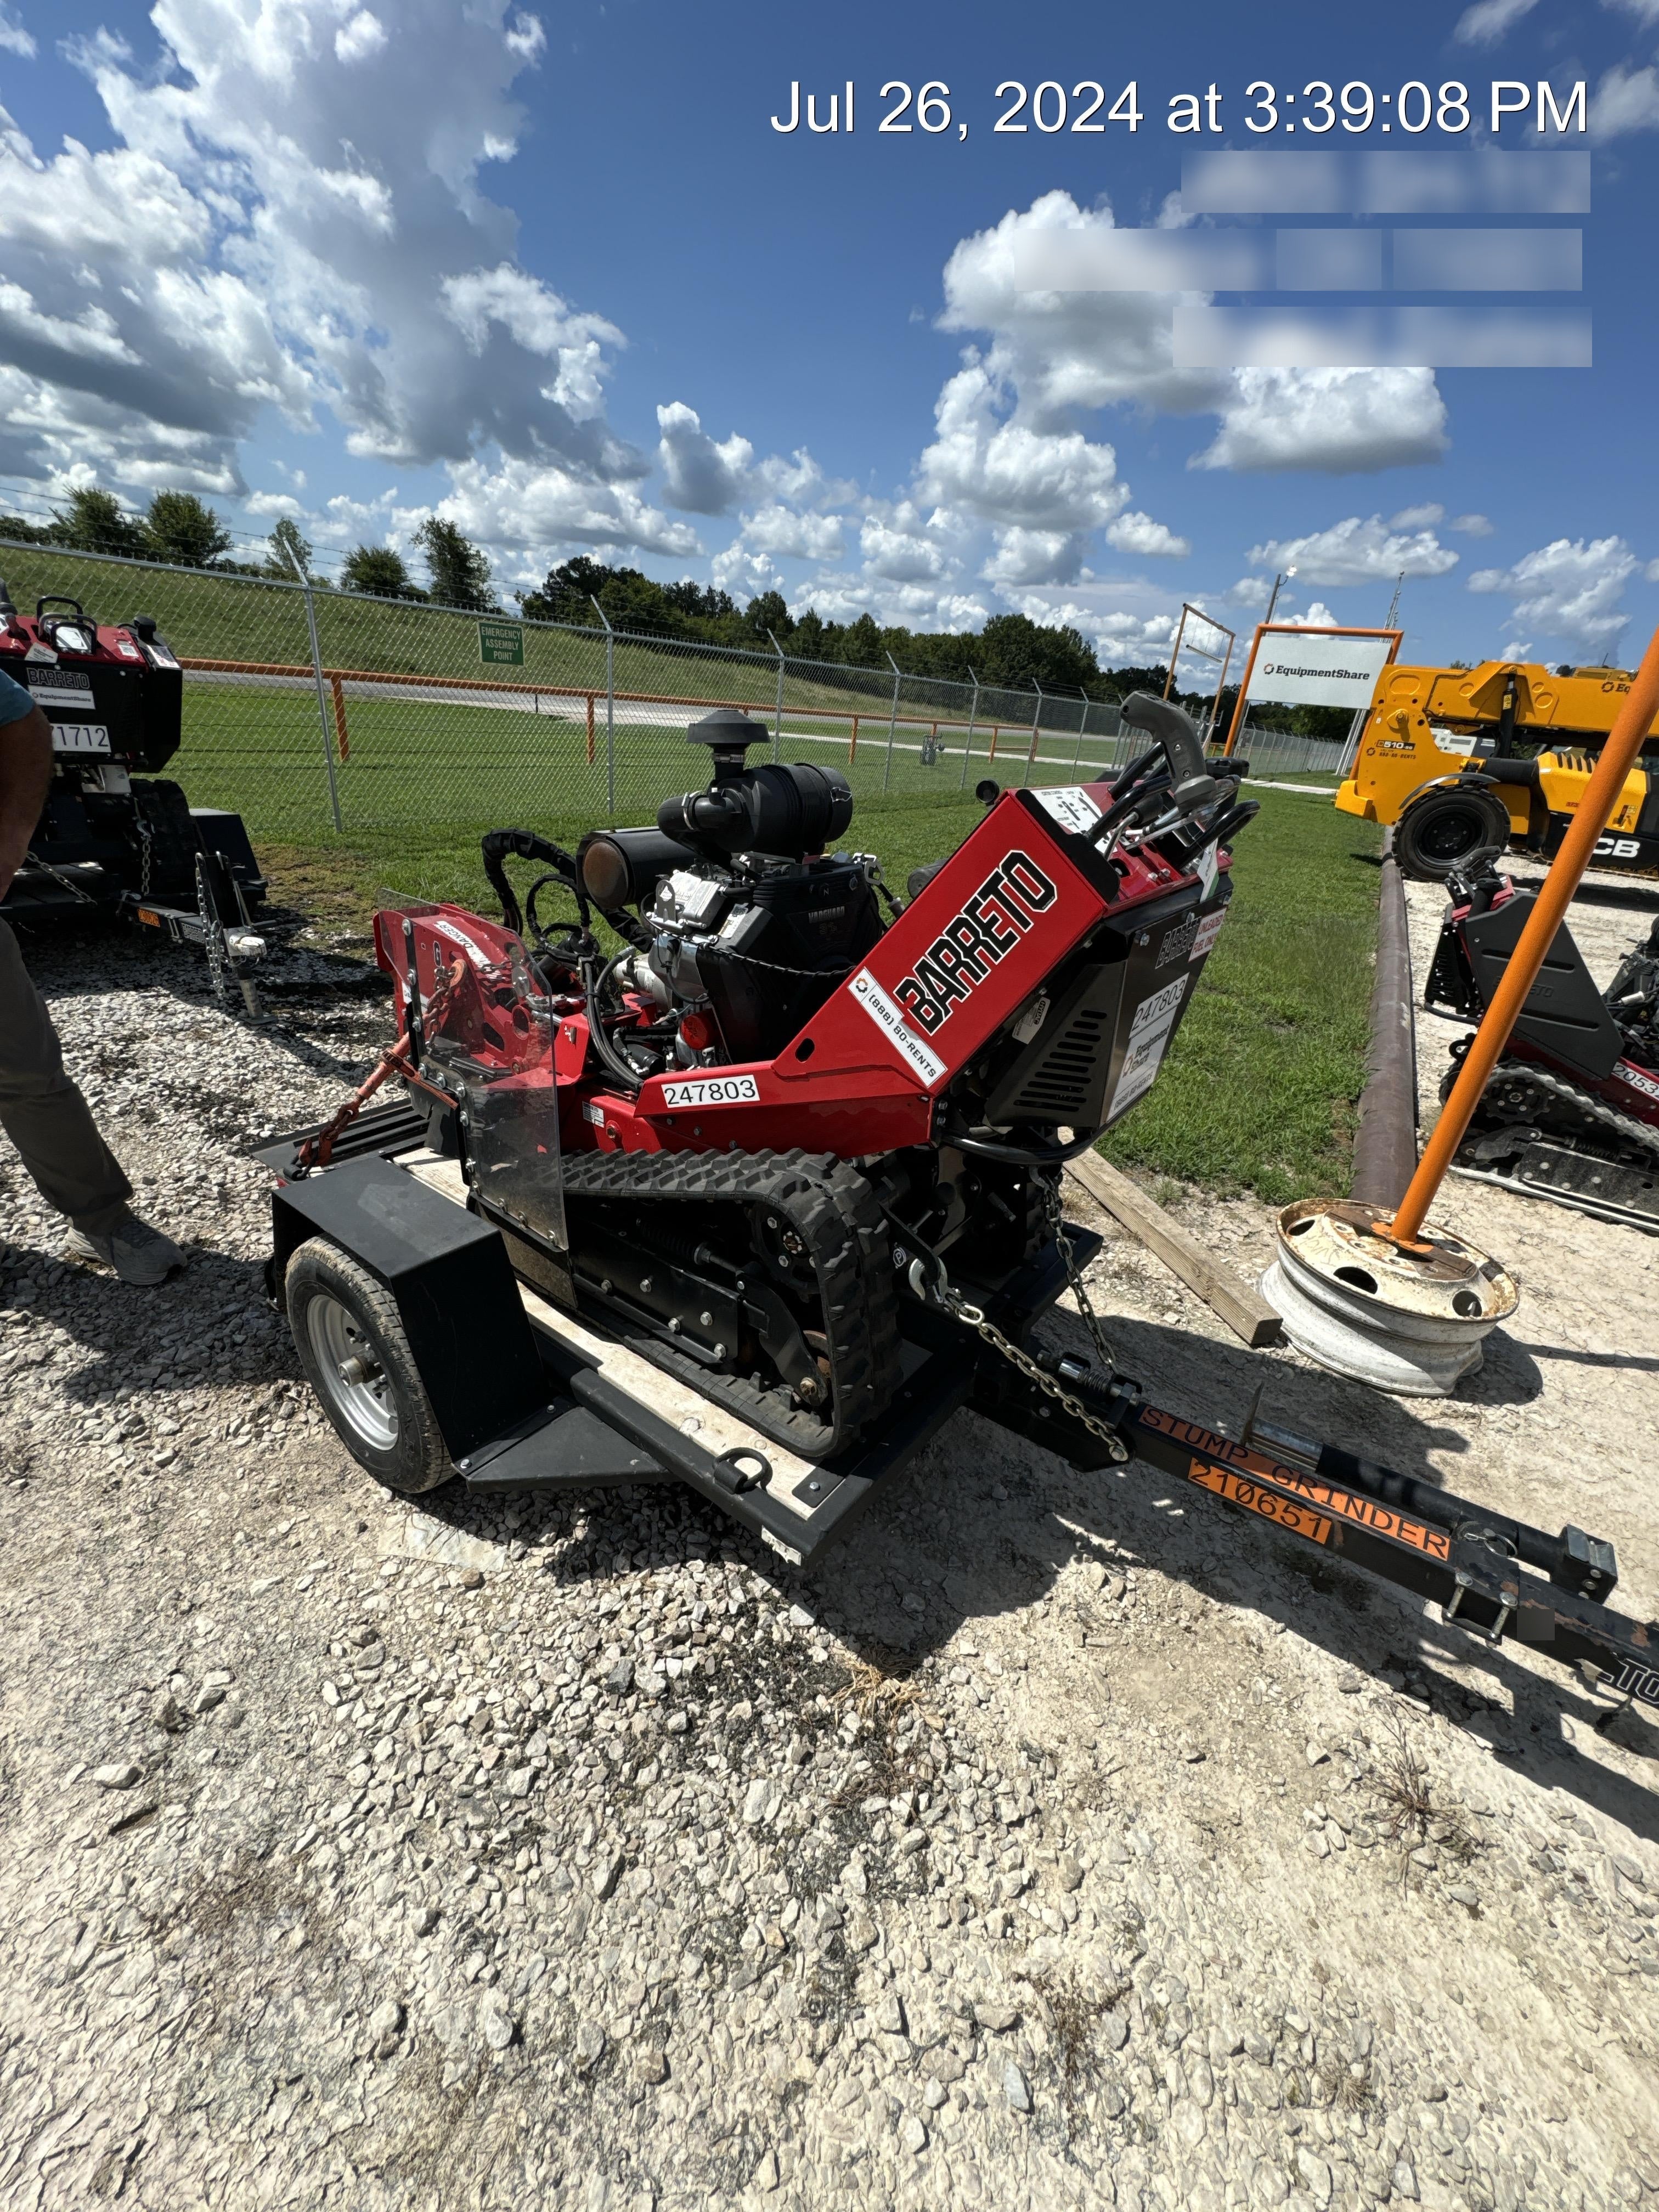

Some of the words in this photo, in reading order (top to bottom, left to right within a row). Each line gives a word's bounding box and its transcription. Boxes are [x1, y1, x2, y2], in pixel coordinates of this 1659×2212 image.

[481, 627, 521, 640] EMERGENCY
[486, 639, 519, 651] ASSEMBLY
[494, 651, 513, 661] POINT
[26, 667, 91, 690] BARRETO
[1276, 665, 1370, 680] EquipmentShare
[51, 726, 109, 747] 1712
[1592, 837, 1641, 858] CB
[439, 924, 474, 949] DANGER
[893, 849, 1058, 1037] BARRETO
[1131, 979, 1186, 1032] 247803
[868, 994, 895, 1026] (888)
[893, 1025, 936, 1077] 80-RENTS
[664, 1080, 755, 1105] 247803
[1611, 1065, 1659, 1098] 2053
[1142, 1408, 1249, 1461] STUMP
[1271, 1465, 1448, 1559] GRINDER
[1597, 1657, 1659, 1705] TO
